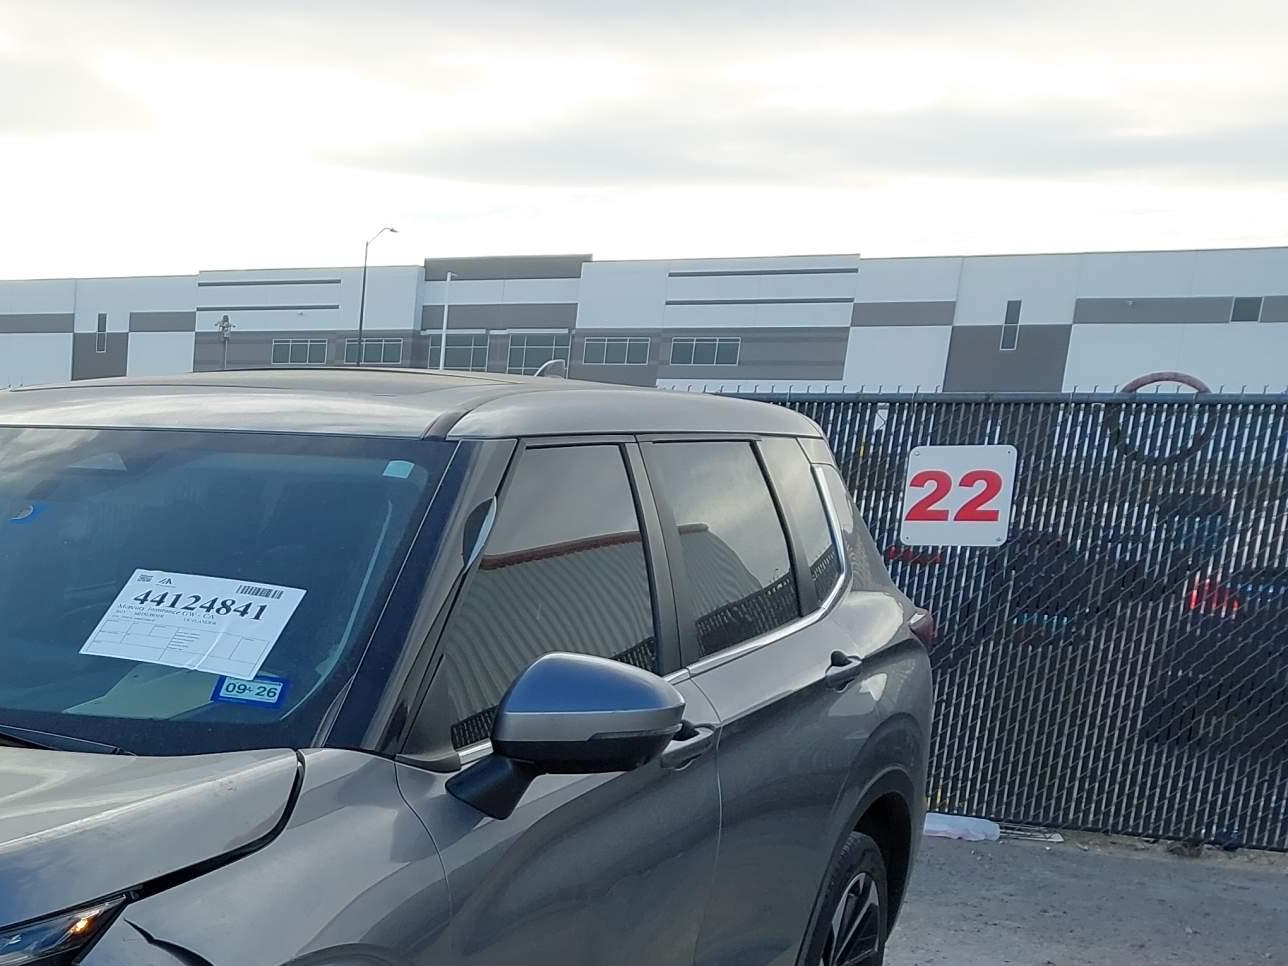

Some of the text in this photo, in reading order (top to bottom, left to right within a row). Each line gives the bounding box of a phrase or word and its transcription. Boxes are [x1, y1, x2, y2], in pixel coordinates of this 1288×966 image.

[905, 470, 1003, 522] 22
[133, 589, 268, 621] 44124841
[225, 682, 278, 698] 09 26
